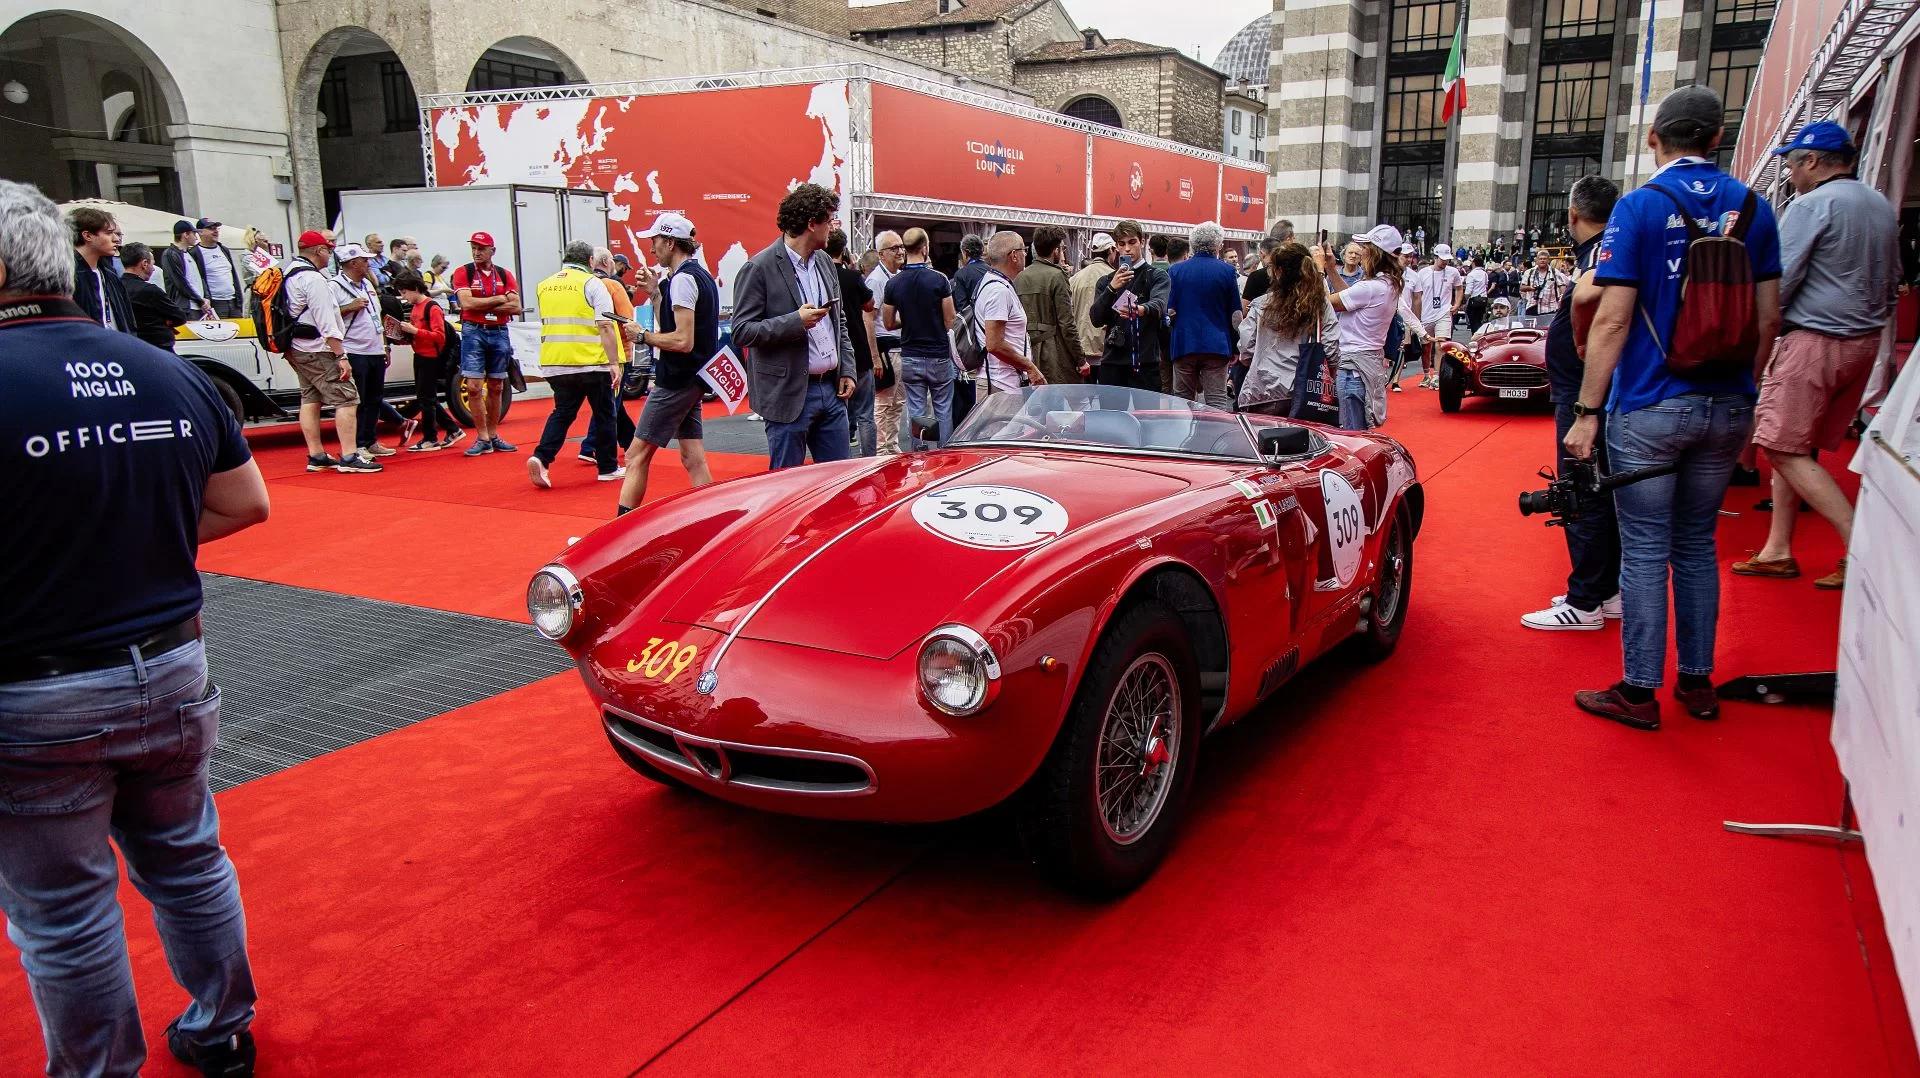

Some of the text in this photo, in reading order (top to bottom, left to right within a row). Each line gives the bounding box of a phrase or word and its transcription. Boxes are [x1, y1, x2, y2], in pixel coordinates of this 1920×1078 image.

[966, 140, 1024, 161] 1000 MIGLIA
[976, 158, 1016, 175] LOUNGE
[659, 224, 673, 234] 1927
[542, 284, 578, 292] MARSHAL
[65, 361, 124, 379] 1000
[708, 365, 736, 398] MIGLIA
[720, 359, 742, 387] 1000
[71, 379, 136, 398] MIGLIA
[25, 419, 193, 458] OFFICER
[937, 500, 1043, 526] 309
[1332, 504, 1360, 549] 309
[626, 637, 698, 684] 309
